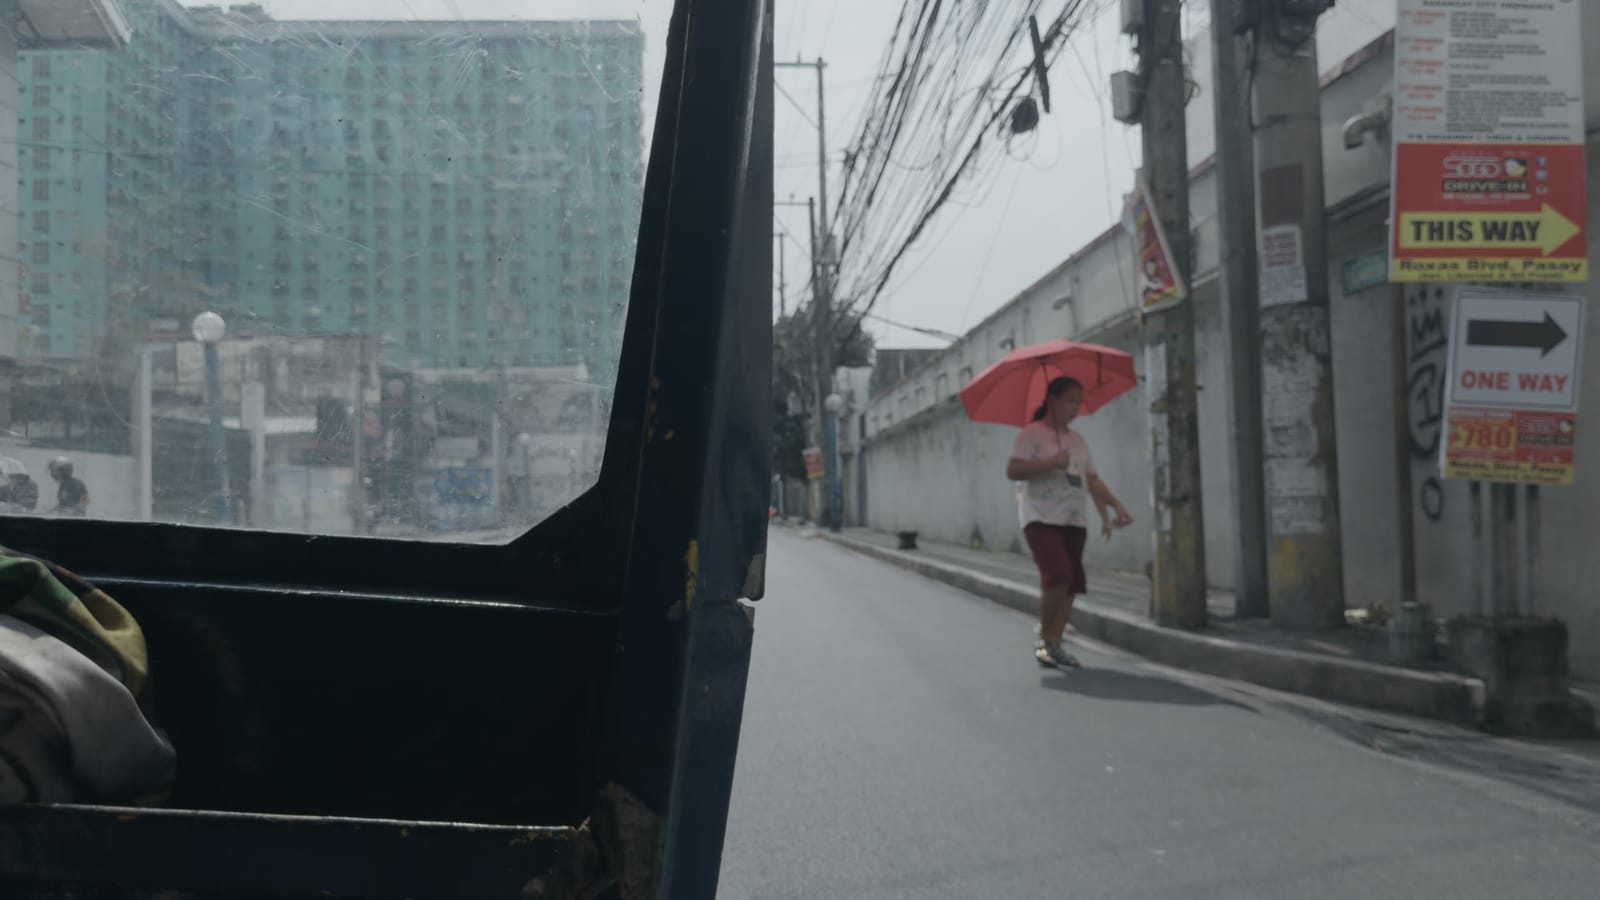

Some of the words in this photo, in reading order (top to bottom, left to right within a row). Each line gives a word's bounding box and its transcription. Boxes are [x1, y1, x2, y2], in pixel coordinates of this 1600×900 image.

[1443, 180, 1527, 192] DRIVE-IN
[1410, 220, 1473, 241] THIS
[1481, 220, 1541, 241] WAY
[1399, 260, 1459, 271] Roxas
[1522, 261, 1582, 273] Pasay
[1461, 370, 1511, 390] ONE
[1518, 372, 1568, 392] WAY
